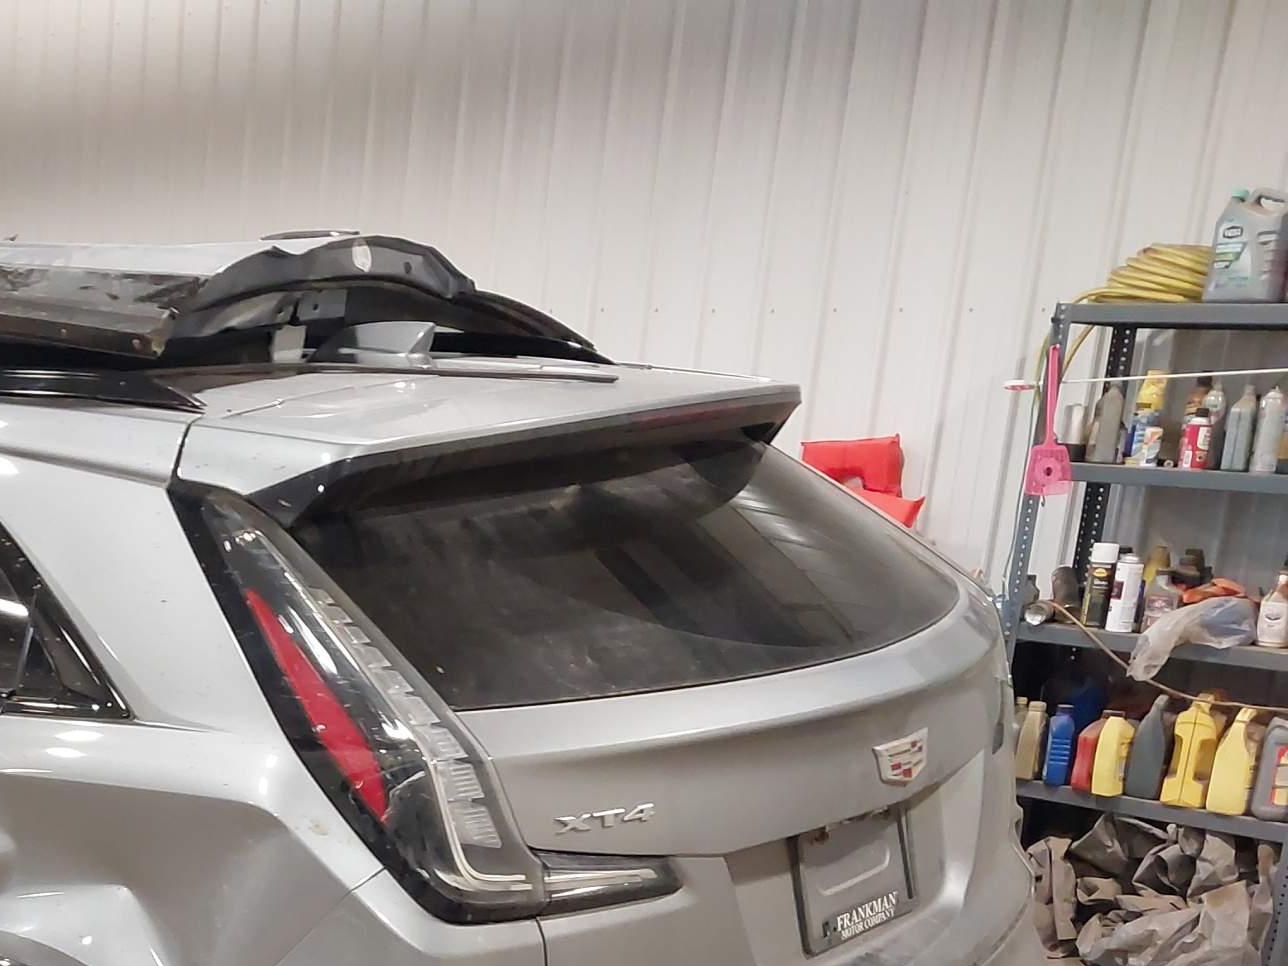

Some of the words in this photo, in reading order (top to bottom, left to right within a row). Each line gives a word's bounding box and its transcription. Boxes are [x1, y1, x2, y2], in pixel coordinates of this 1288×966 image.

[553, 803, 655, 836] XT4
[836, 891, 898, 932] FRANKMAN
[840, 921, 865, 941] MOTOR
[864, 908, 896, 929] COMPANY
